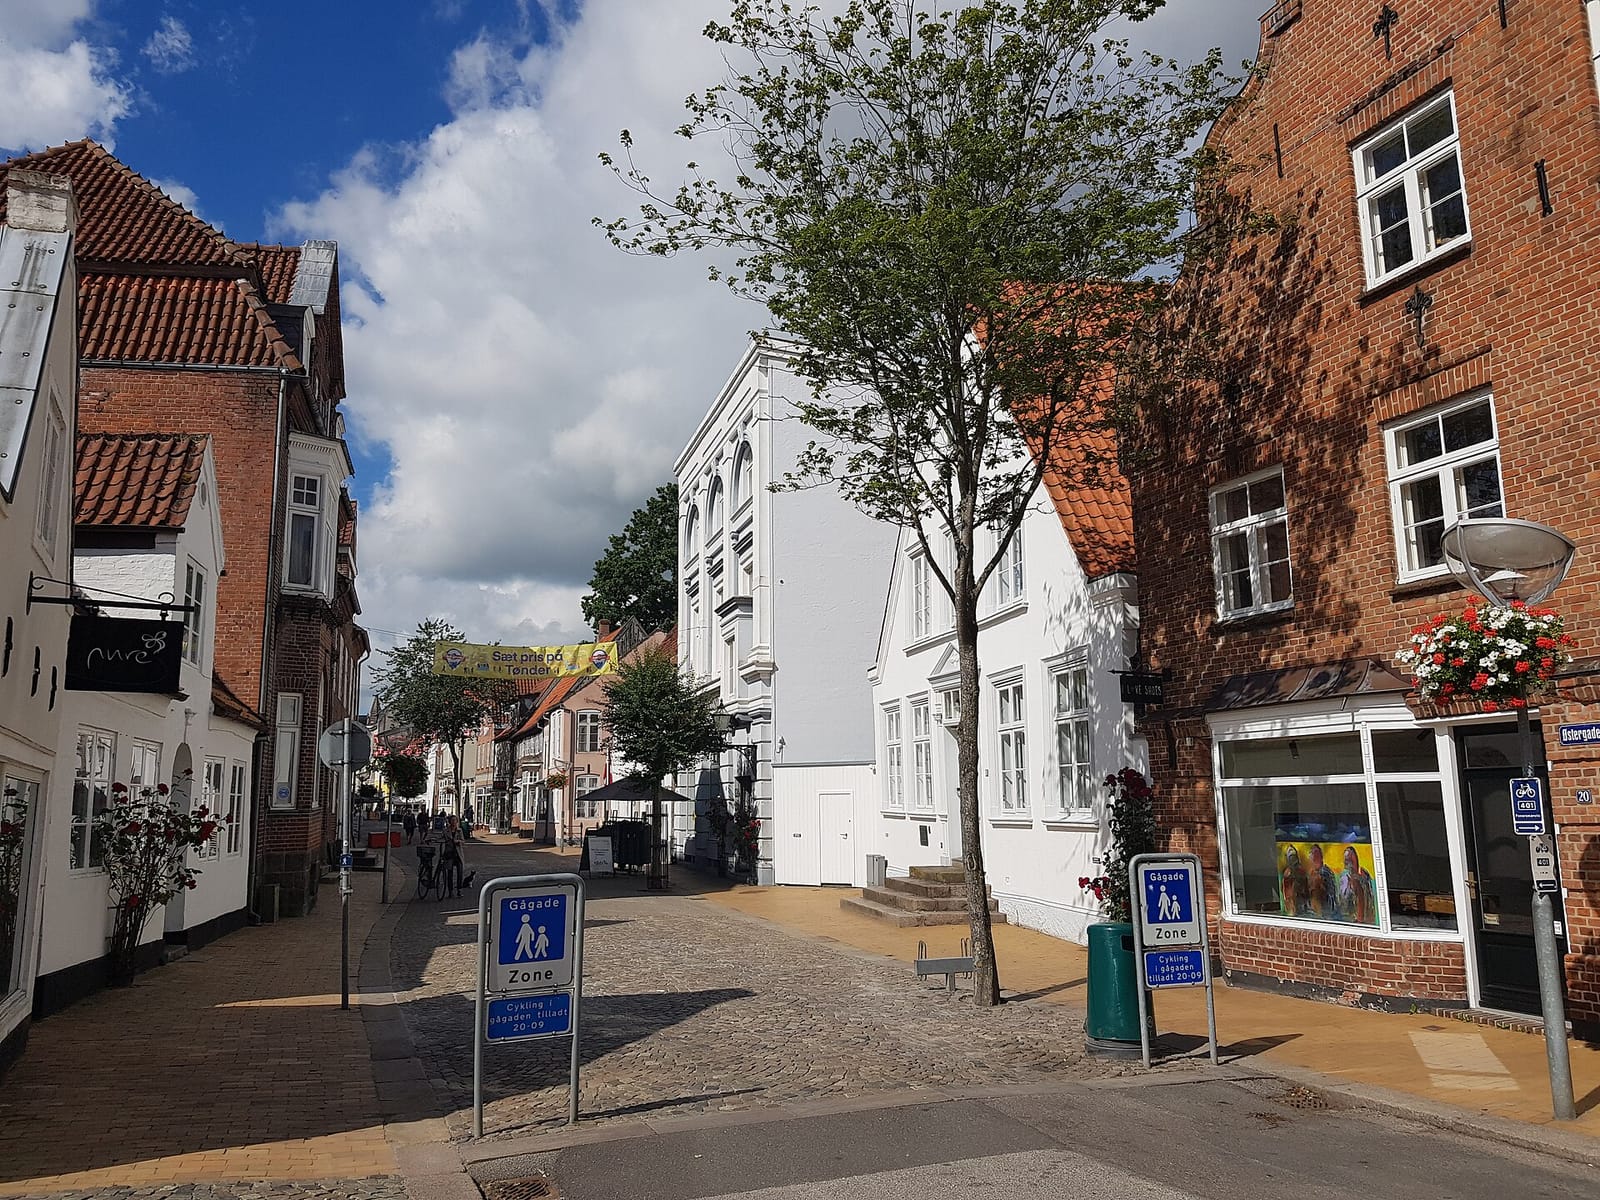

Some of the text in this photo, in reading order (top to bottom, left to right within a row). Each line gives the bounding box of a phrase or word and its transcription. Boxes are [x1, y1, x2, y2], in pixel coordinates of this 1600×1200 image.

[492, 650, 563, 664] Sæt pris på
[506, 665, 551, 675] Tønder
[1578, 790, 1590, 802] 20
[1520, 801, 1534, 809] 401
[1150, 872, 1184, 883] Gågade
[509, 898, 560, 911] Gågade
[1155, 928, 1187, 939] Zone
[1159, 955, 1189, 964] Cykling
[1160, 964, 1194, 974] gågaden
[508, 969, 553, 984] Zone
[1148, 971, 1202, 982] tilladt 20-09
[507, 1001, 544, 1012] Cykling
[489, 1008, 568, 1025] gågaden tilladt
[513, 1021, 545, 1032] 20-09
